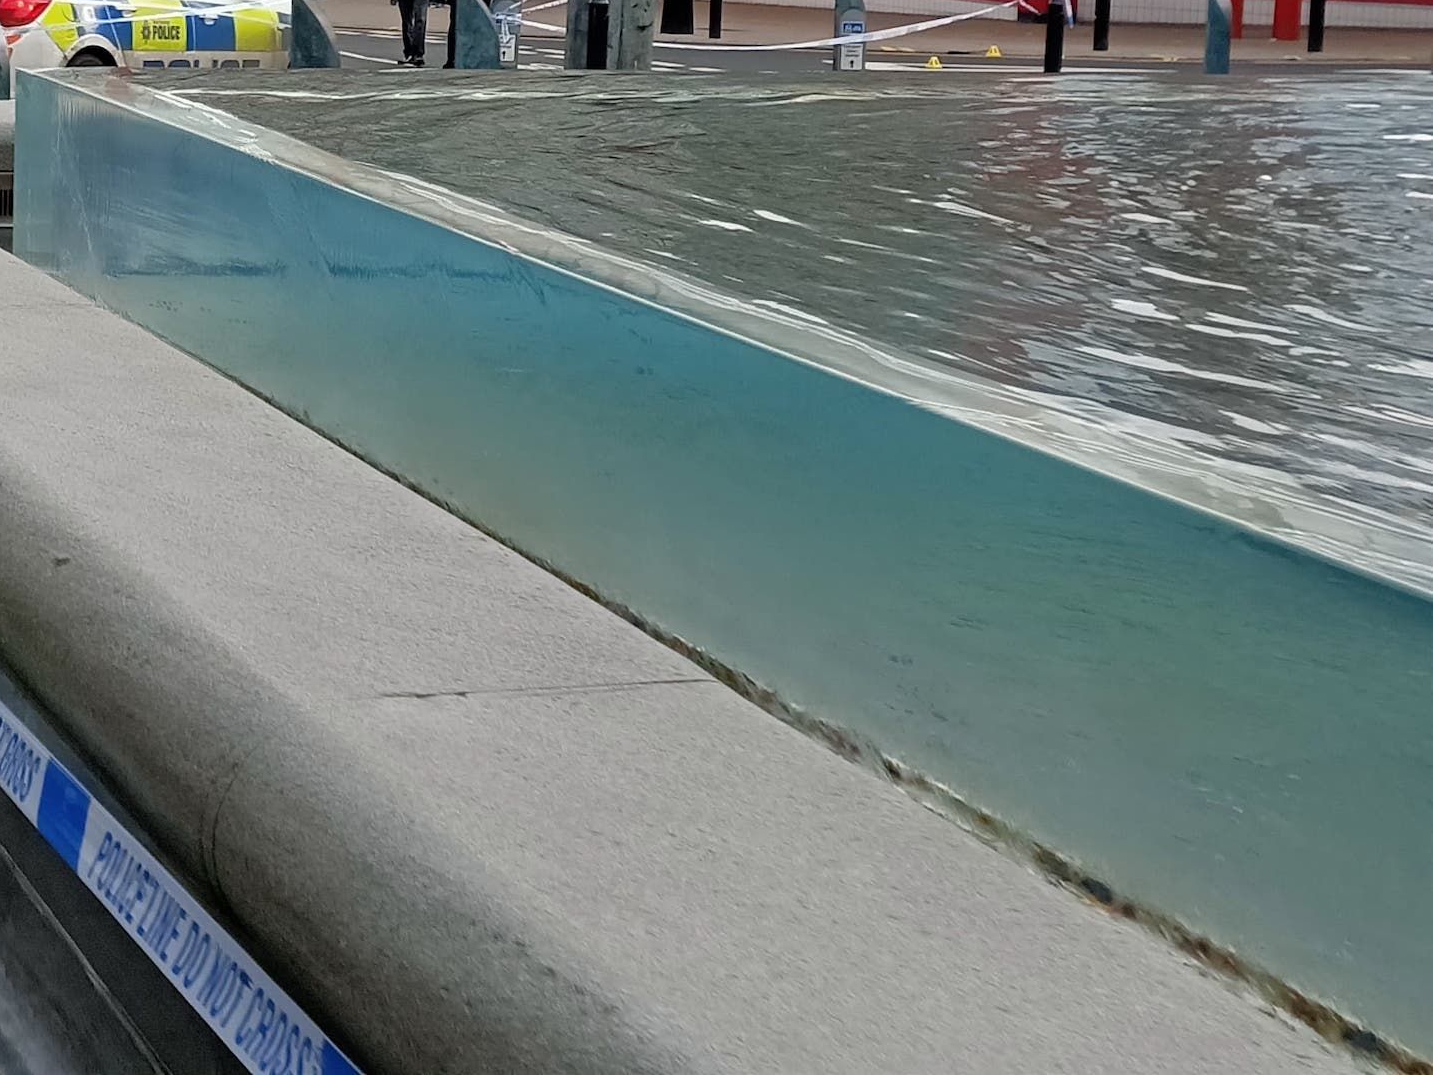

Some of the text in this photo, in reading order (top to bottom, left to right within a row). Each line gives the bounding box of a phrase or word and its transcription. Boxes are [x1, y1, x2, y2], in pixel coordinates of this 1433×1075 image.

[152, 26, 180, 40] POLICE
[87, 830, 152, 926] POLICE
[135, 880, 187, 964] LINE
[171, 921, 211, 990] DO
[195, 940, 254, 1028] NOT
